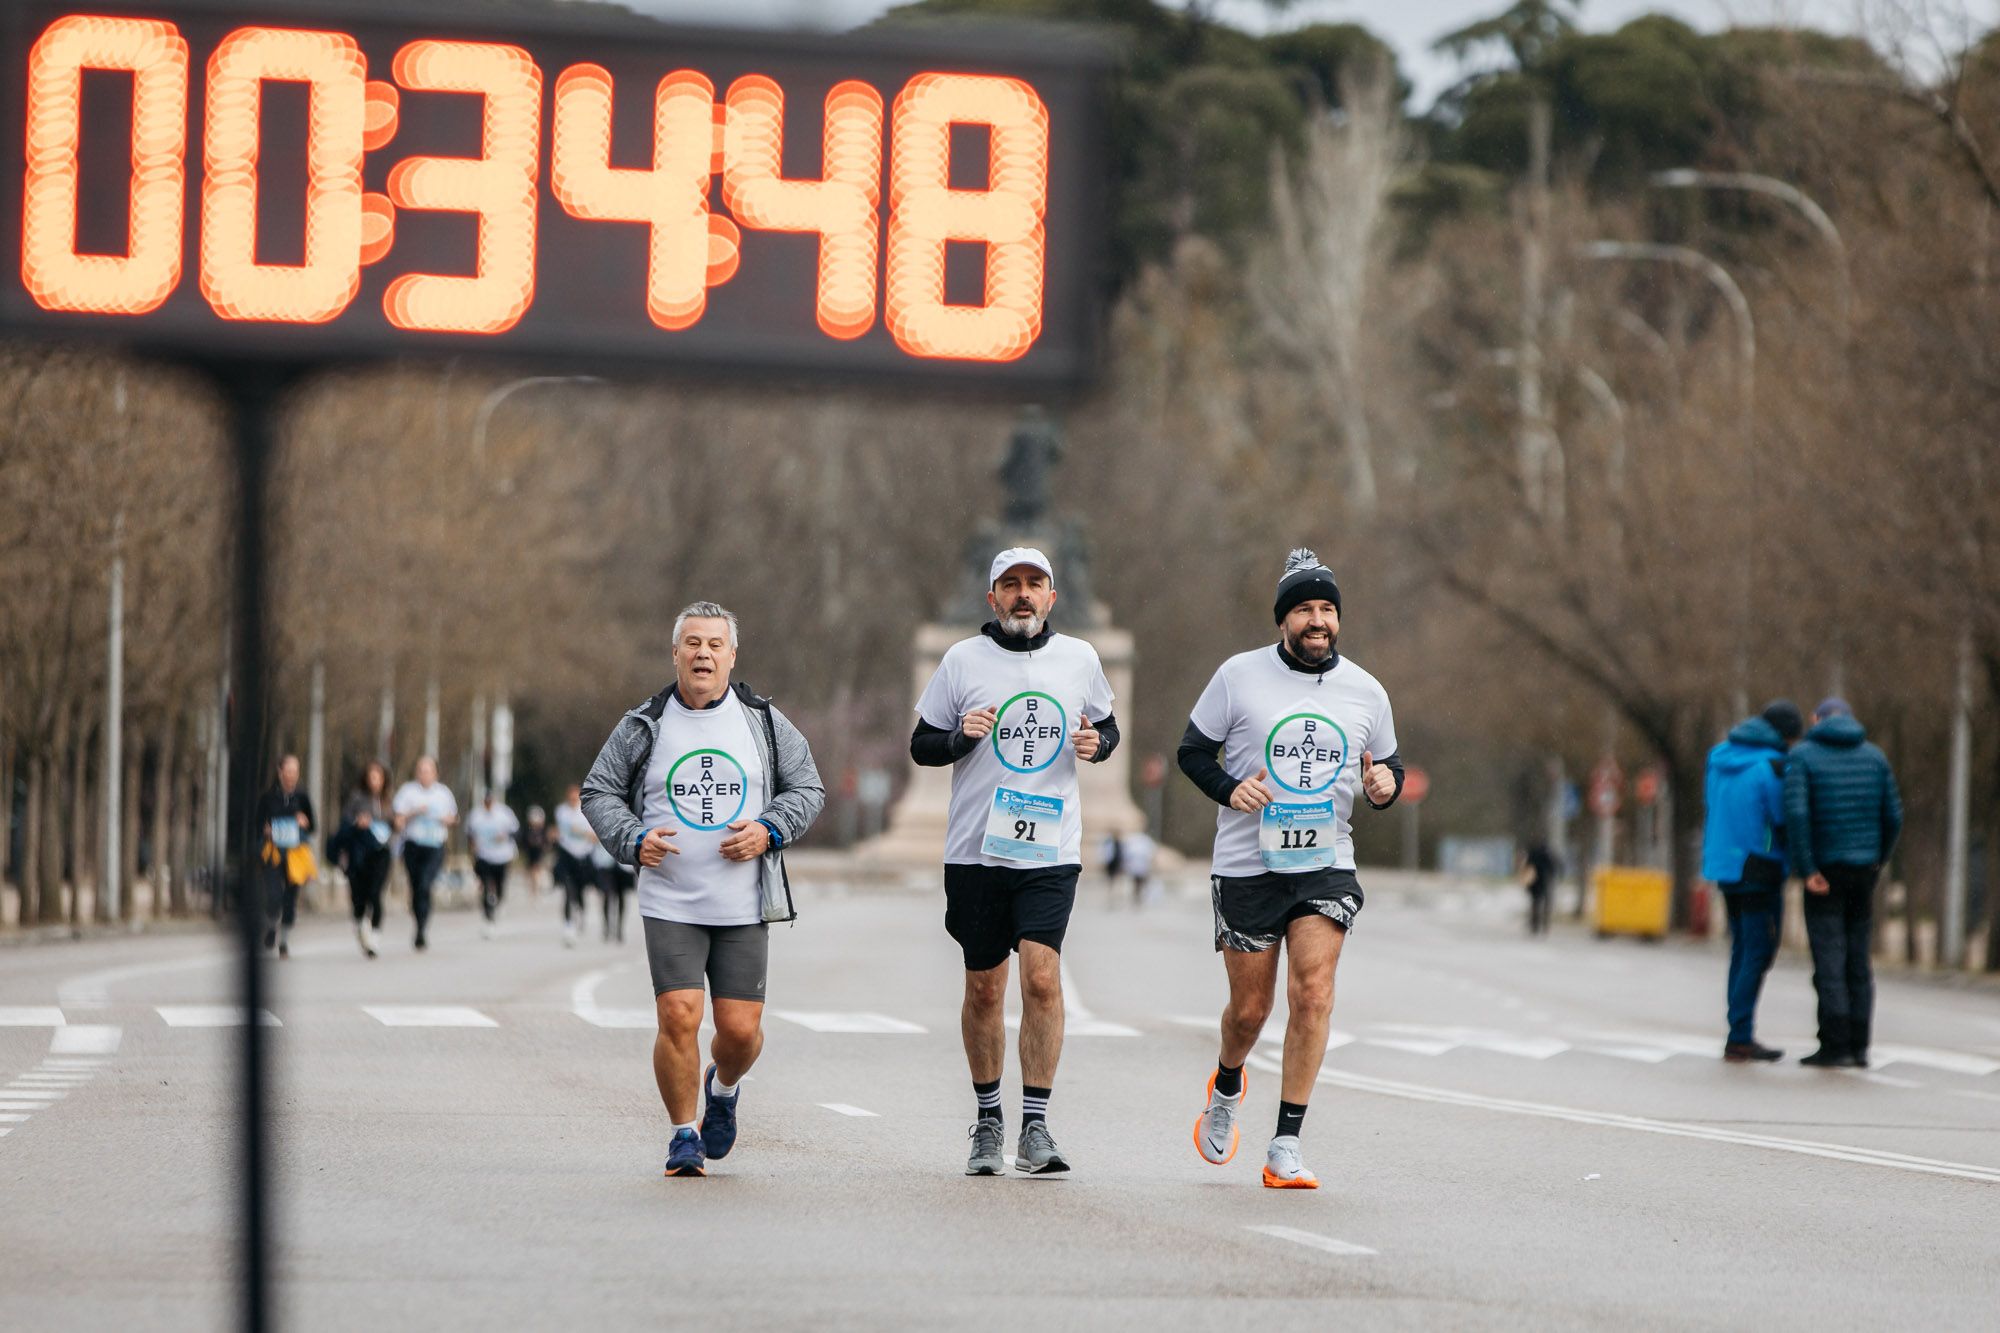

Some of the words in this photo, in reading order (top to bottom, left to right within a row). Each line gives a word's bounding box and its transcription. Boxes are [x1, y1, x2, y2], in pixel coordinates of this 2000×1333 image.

[1000, 726, 1061, 740] BAYER
[1022, 698, 1038, 767] BAYER
[1273, 744, 1341, 763] BAYER
[1299, 720, 1317, 789] BAYER
[673, 783, 741, 796] BAYER
[700, 756, 715, 824] BAYER
[1014, 819, 1037, 842] 91
[1280, 829, 1318, 849] 112
